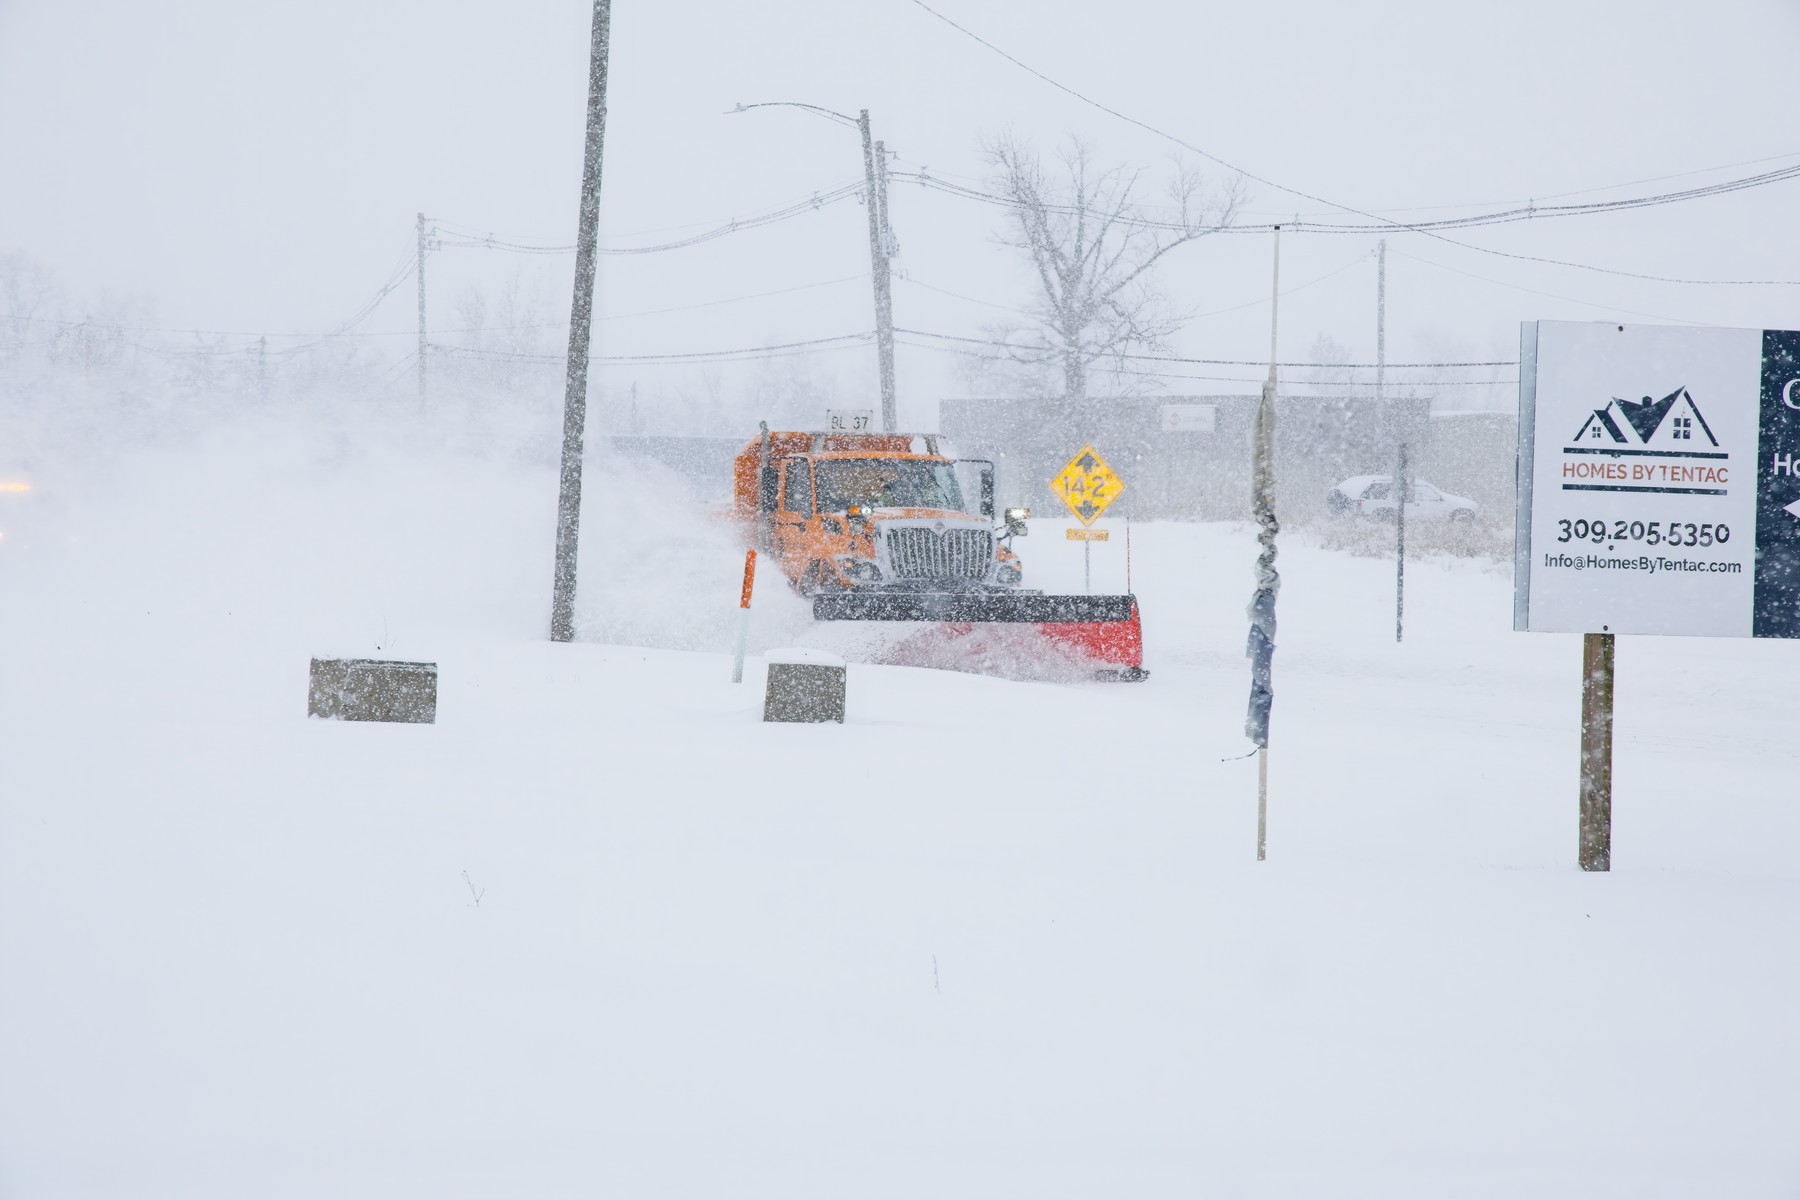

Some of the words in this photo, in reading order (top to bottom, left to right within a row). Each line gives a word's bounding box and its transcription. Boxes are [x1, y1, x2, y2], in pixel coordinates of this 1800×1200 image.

[831, 416, 846, 430] BL
[853, 416, 869, 430] 37
[1563, 462, 1628, 480] HOMES
[1632, 464, 1656, 481] BY
[1659, 465, 1729, 484] TENTAC
[1557, 518, 1731, 548] 309.205.5350
[1544, 553, 1742, 574] Info@HomesByTentac.com
